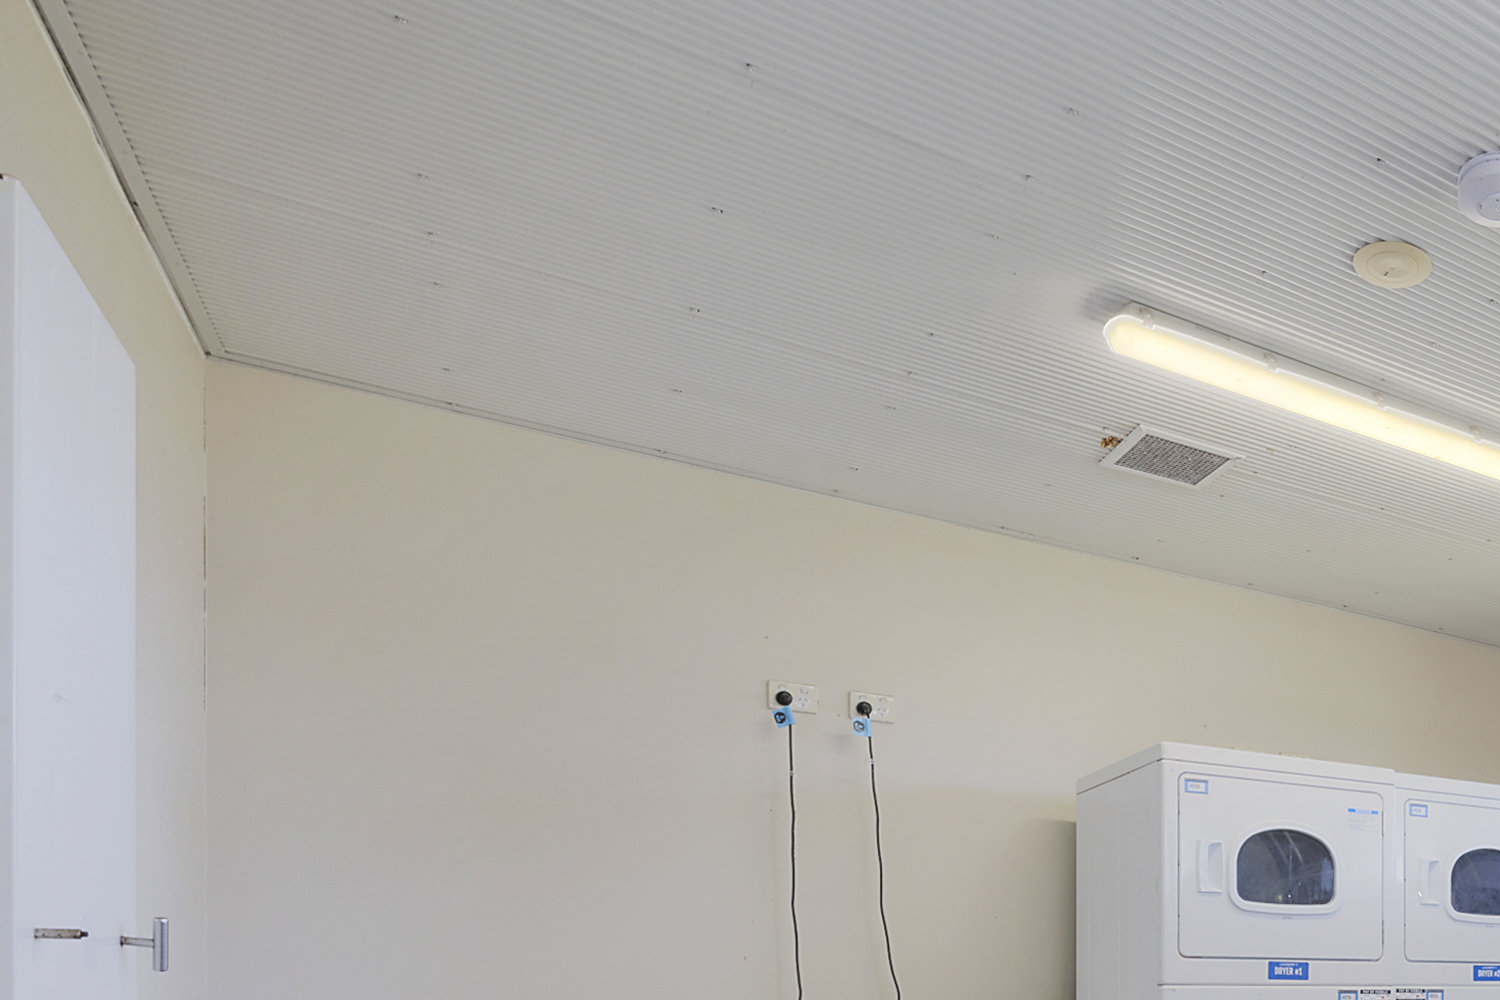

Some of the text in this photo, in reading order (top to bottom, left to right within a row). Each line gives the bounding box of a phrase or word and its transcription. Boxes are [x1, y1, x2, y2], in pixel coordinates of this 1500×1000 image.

[1274, 966, 1303, 976] DRYER #1
[1477, 969, 1494, 978] DRYER
